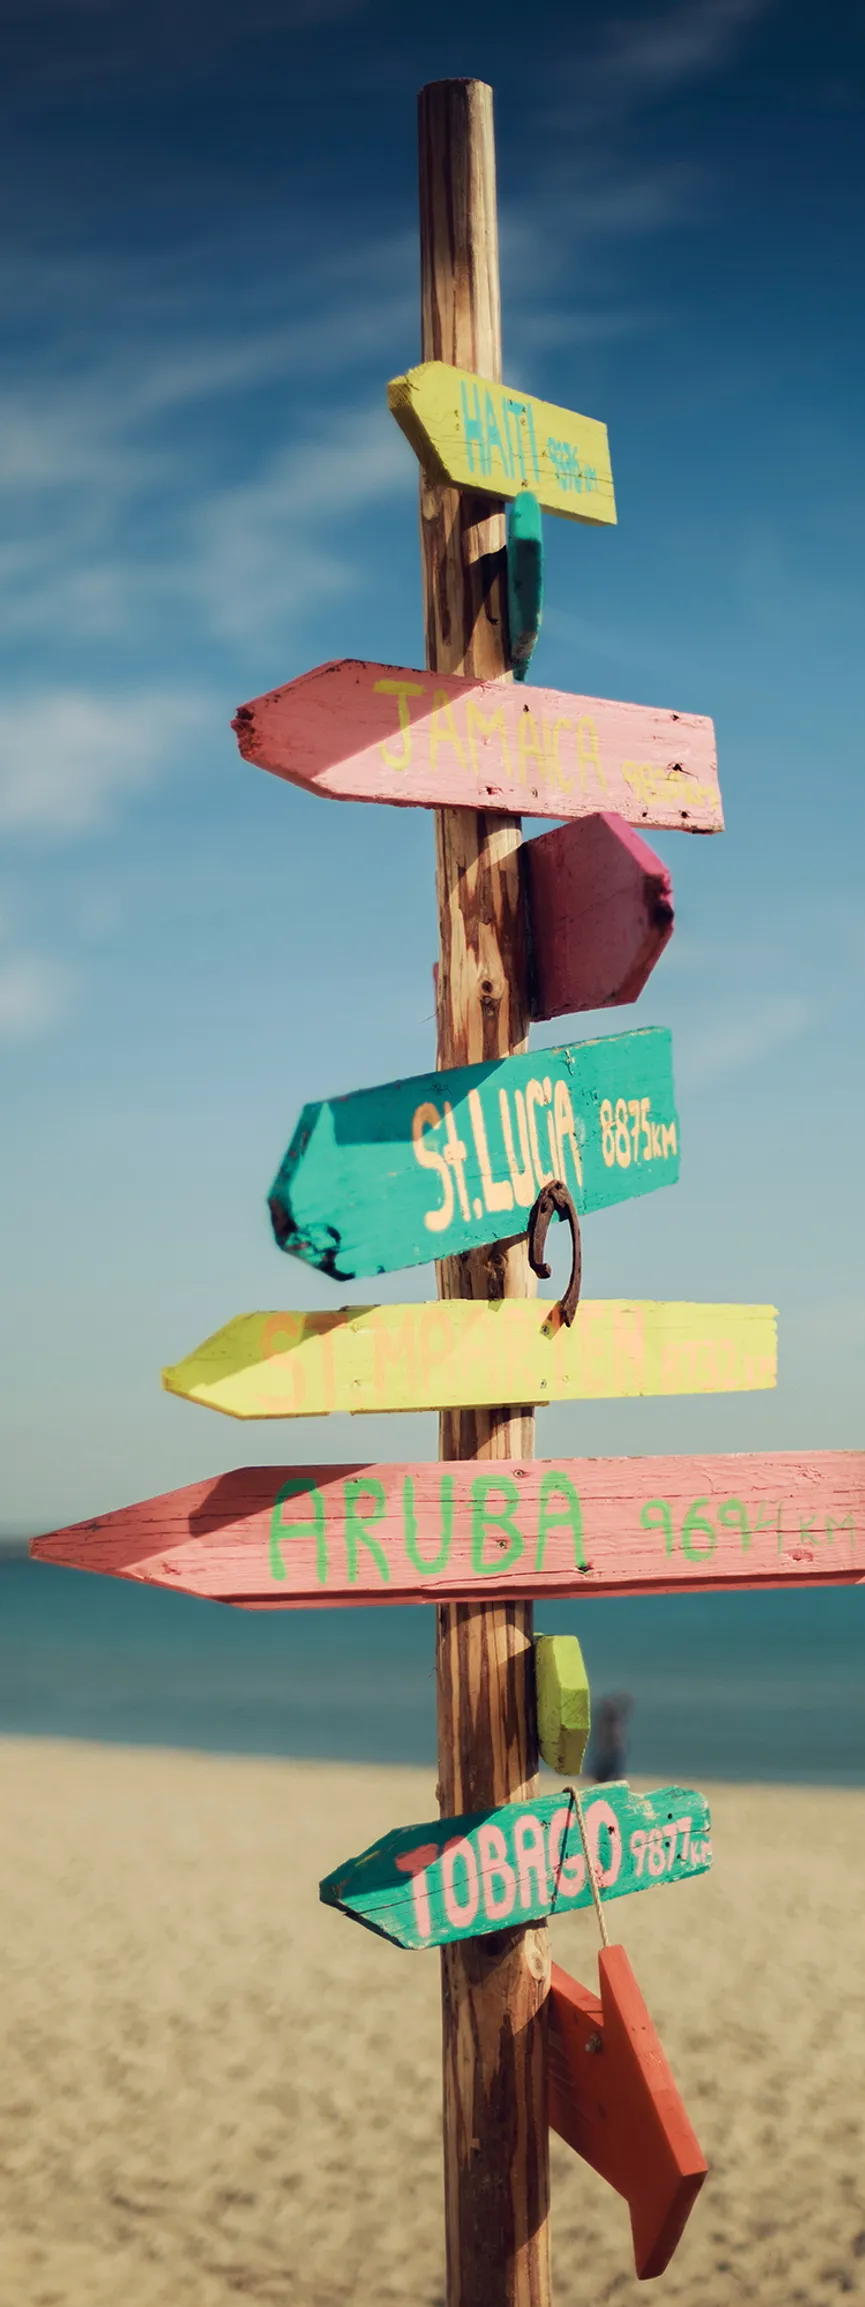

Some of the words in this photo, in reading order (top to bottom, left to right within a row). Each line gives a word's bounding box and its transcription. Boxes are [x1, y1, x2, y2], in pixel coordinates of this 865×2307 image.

[460, 380, 540, 483] HAITI
[373, 679, 607, 793] JAMAICA
[268, 1470, 591, 1583] ARUBA
[640, 1497, 783, 1562] 9694
[800, 1513, 856, 1549] KM
[395, 1800, 622, 1938] TOBAGO
